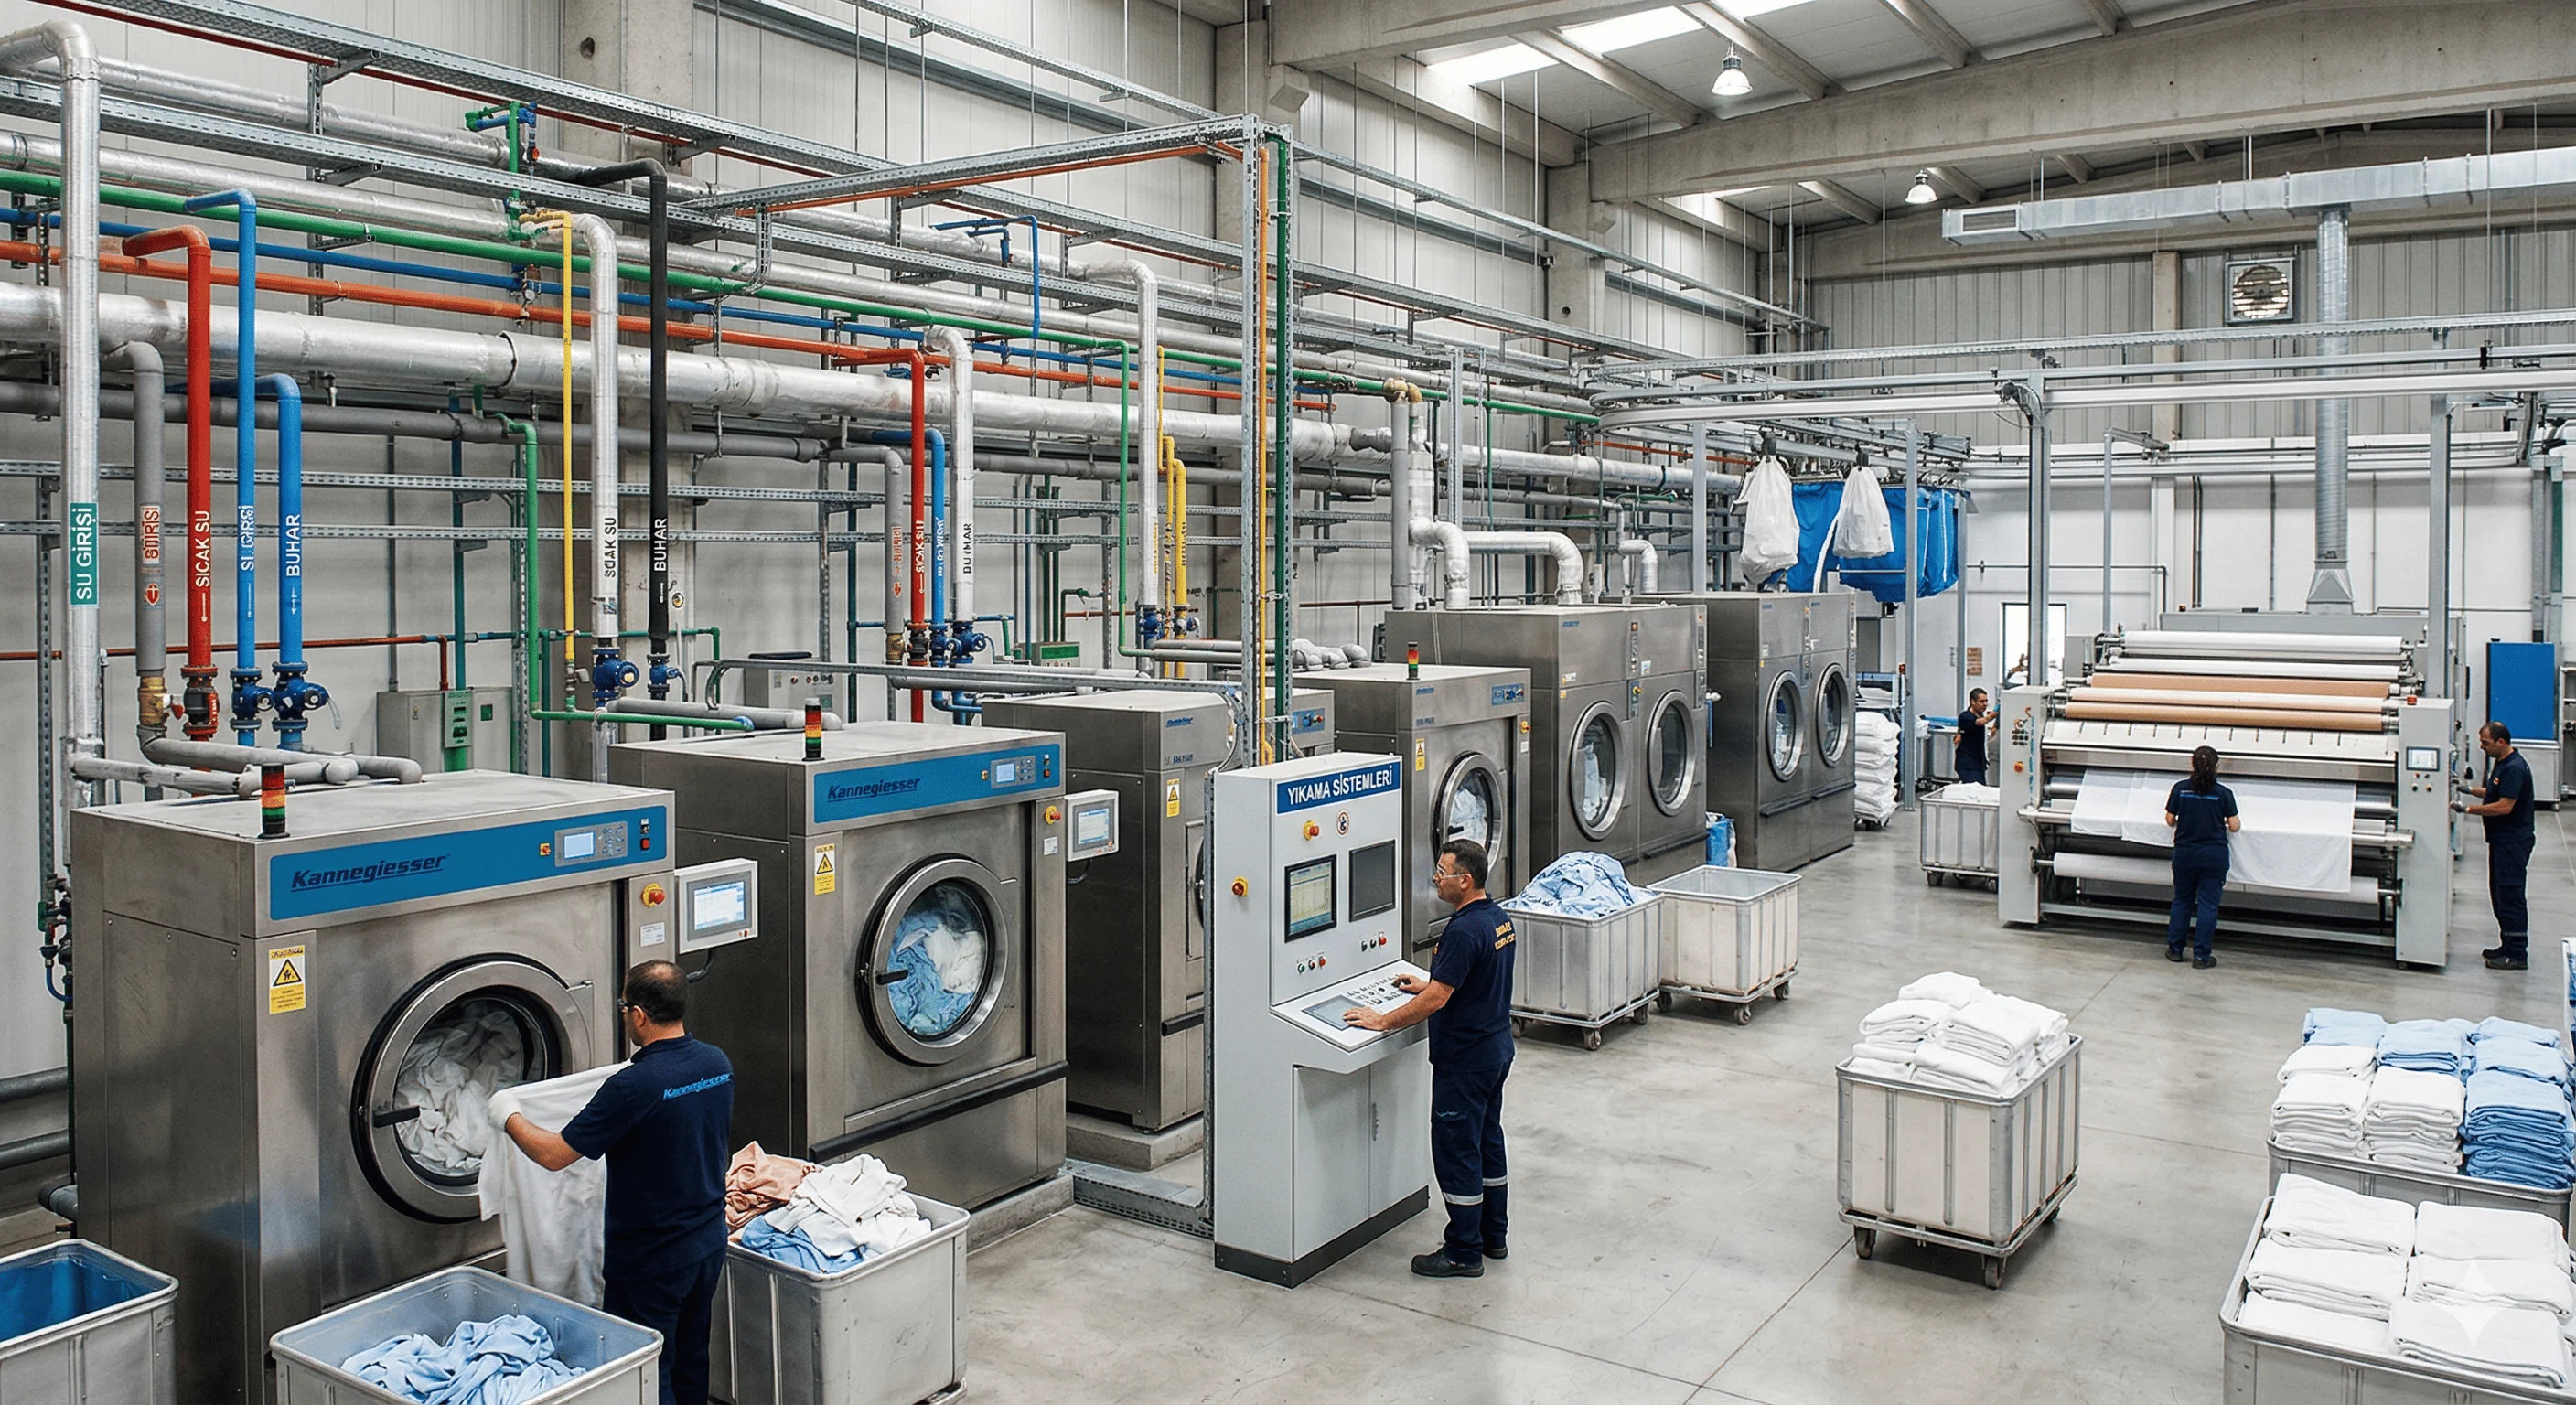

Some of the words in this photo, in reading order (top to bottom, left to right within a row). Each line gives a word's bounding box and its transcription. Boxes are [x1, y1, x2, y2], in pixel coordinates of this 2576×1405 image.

[71, 508, 96, 567] GİRİŞİ
[195, 510, 209, 532] SU
[604, 517, 617, 535] SU
[195, 537, 210, 587] SICAK
[285, 514, 300, 577] BUHAR
[654, 518, 667, 572] BUHAR
[76, 573, 92, 600] SU
[827, 778, 921, 799] Kannegiesser
[1287, 781, 1331, 805] YIKAMA
[1333, 765, 1393, 797] SİSTEMLERİ
[291, 854, 448, 889] Kannegiesser
